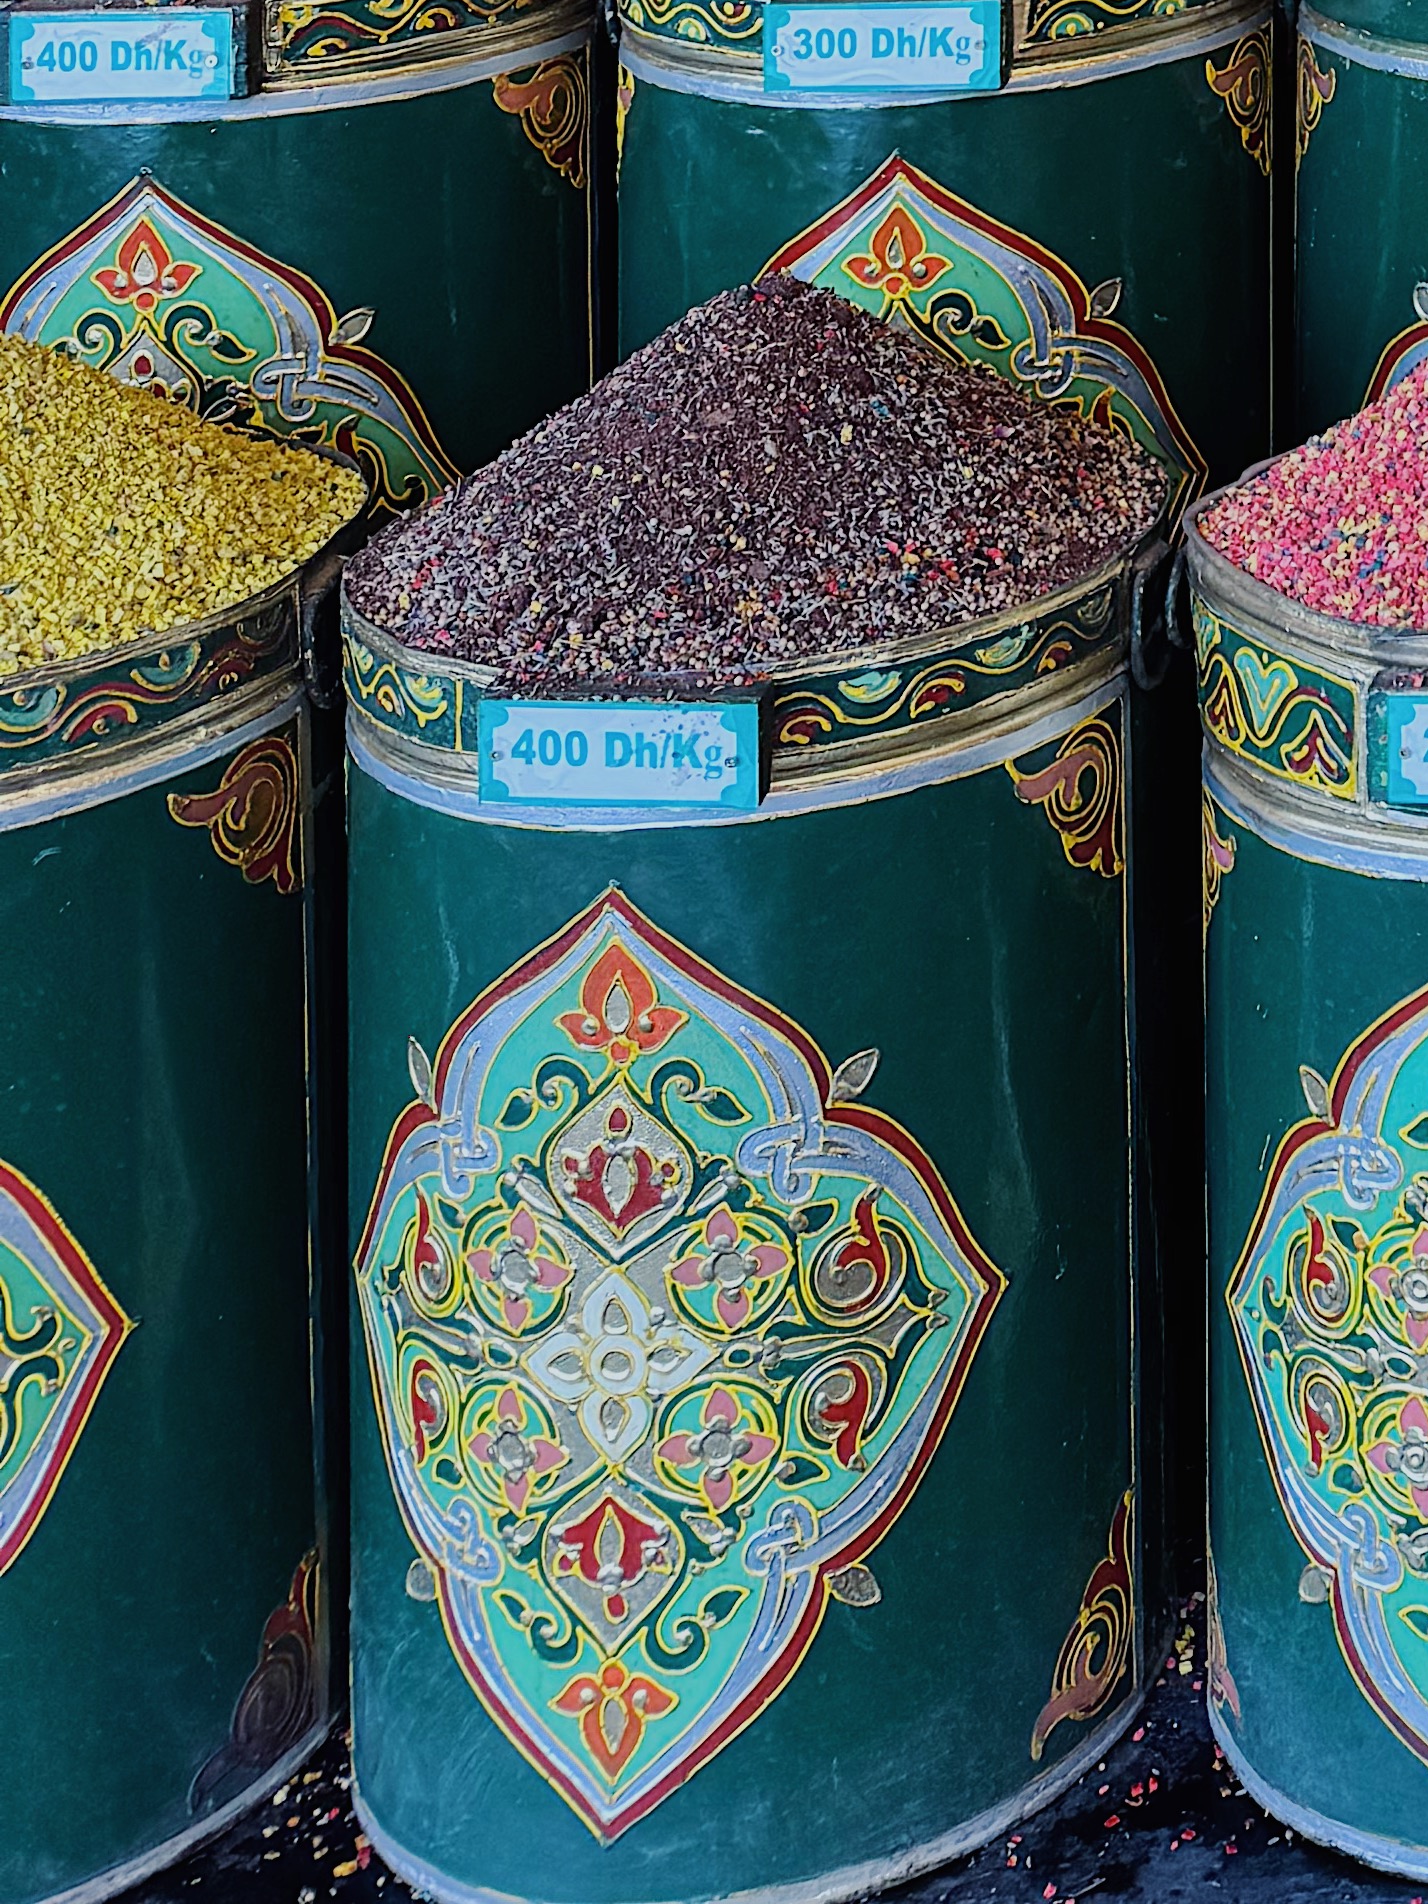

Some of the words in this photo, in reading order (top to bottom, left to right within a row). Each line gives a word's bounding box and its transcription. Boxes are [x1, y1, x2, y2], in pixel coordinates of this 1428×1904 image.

[36, 40, 99, 73] 400
[110, 38, 204, 80] Dh/Kg
[792, 28, 858, 60] 300
[870, 26, 972, 66] Dh/Kg
[510, 727, 589, 767] 400
[603, 730, 724, 781] Dh/Kg
